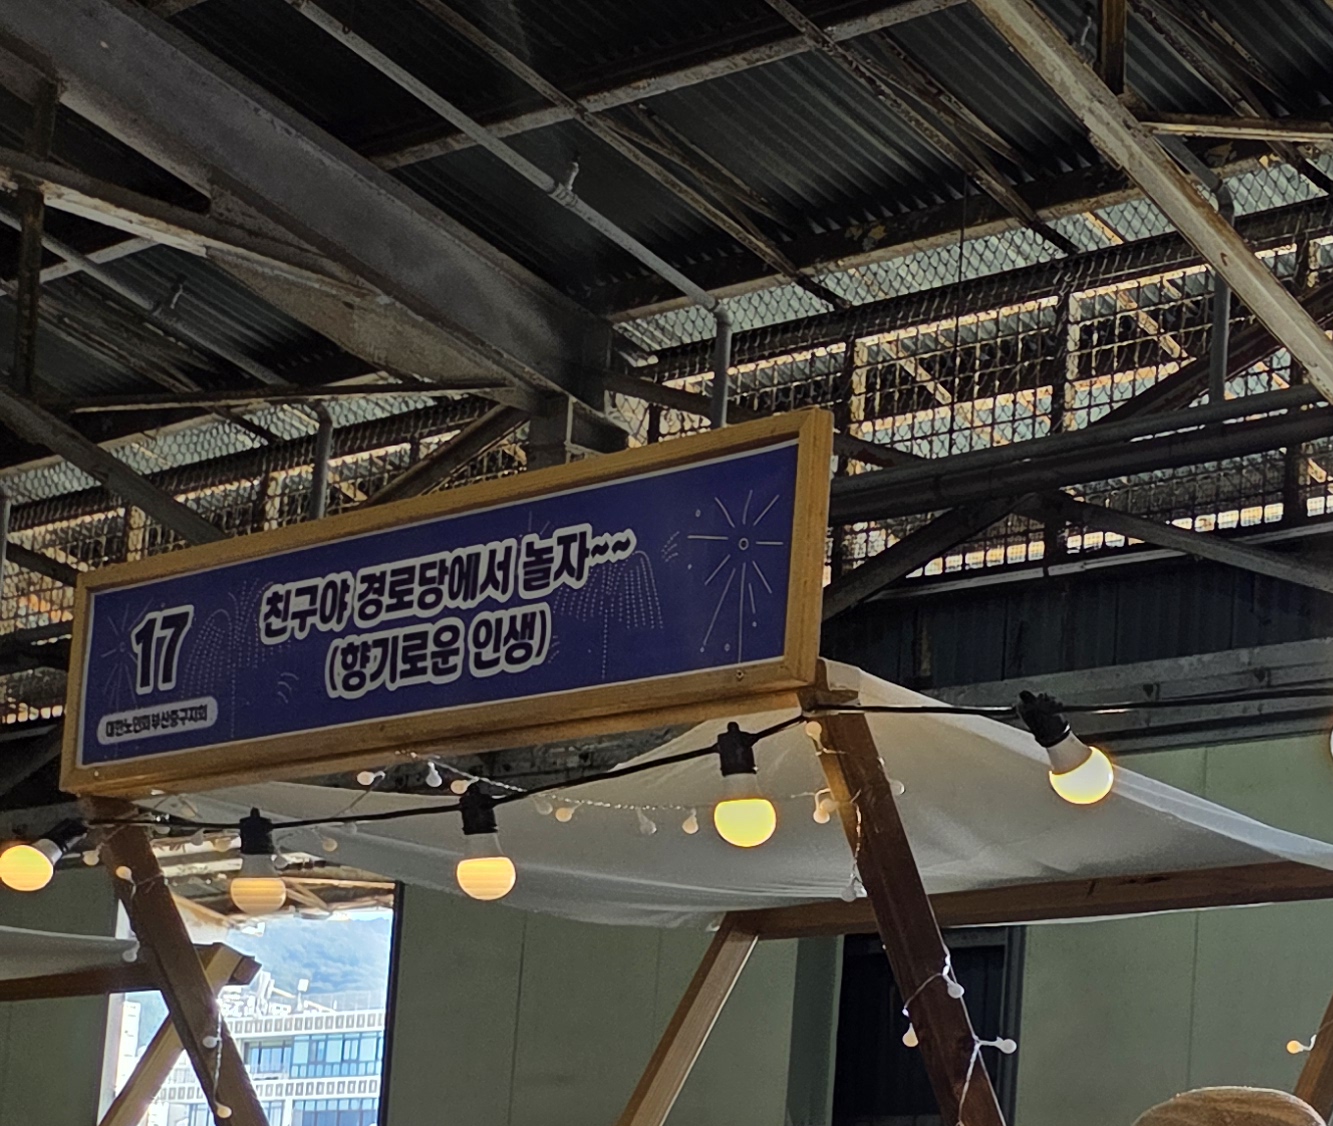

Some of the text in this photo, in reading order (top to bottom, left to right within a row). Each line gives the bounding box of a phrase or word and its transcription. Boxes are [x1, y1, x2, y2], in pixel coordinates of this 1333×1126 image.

[262, 579, 351, 639] 친구야
[356, 545, 514, 622] 경로당에서
[134, 610, 191, 690] 17
[328, 609, 548, 693] (향기로운 인생)
